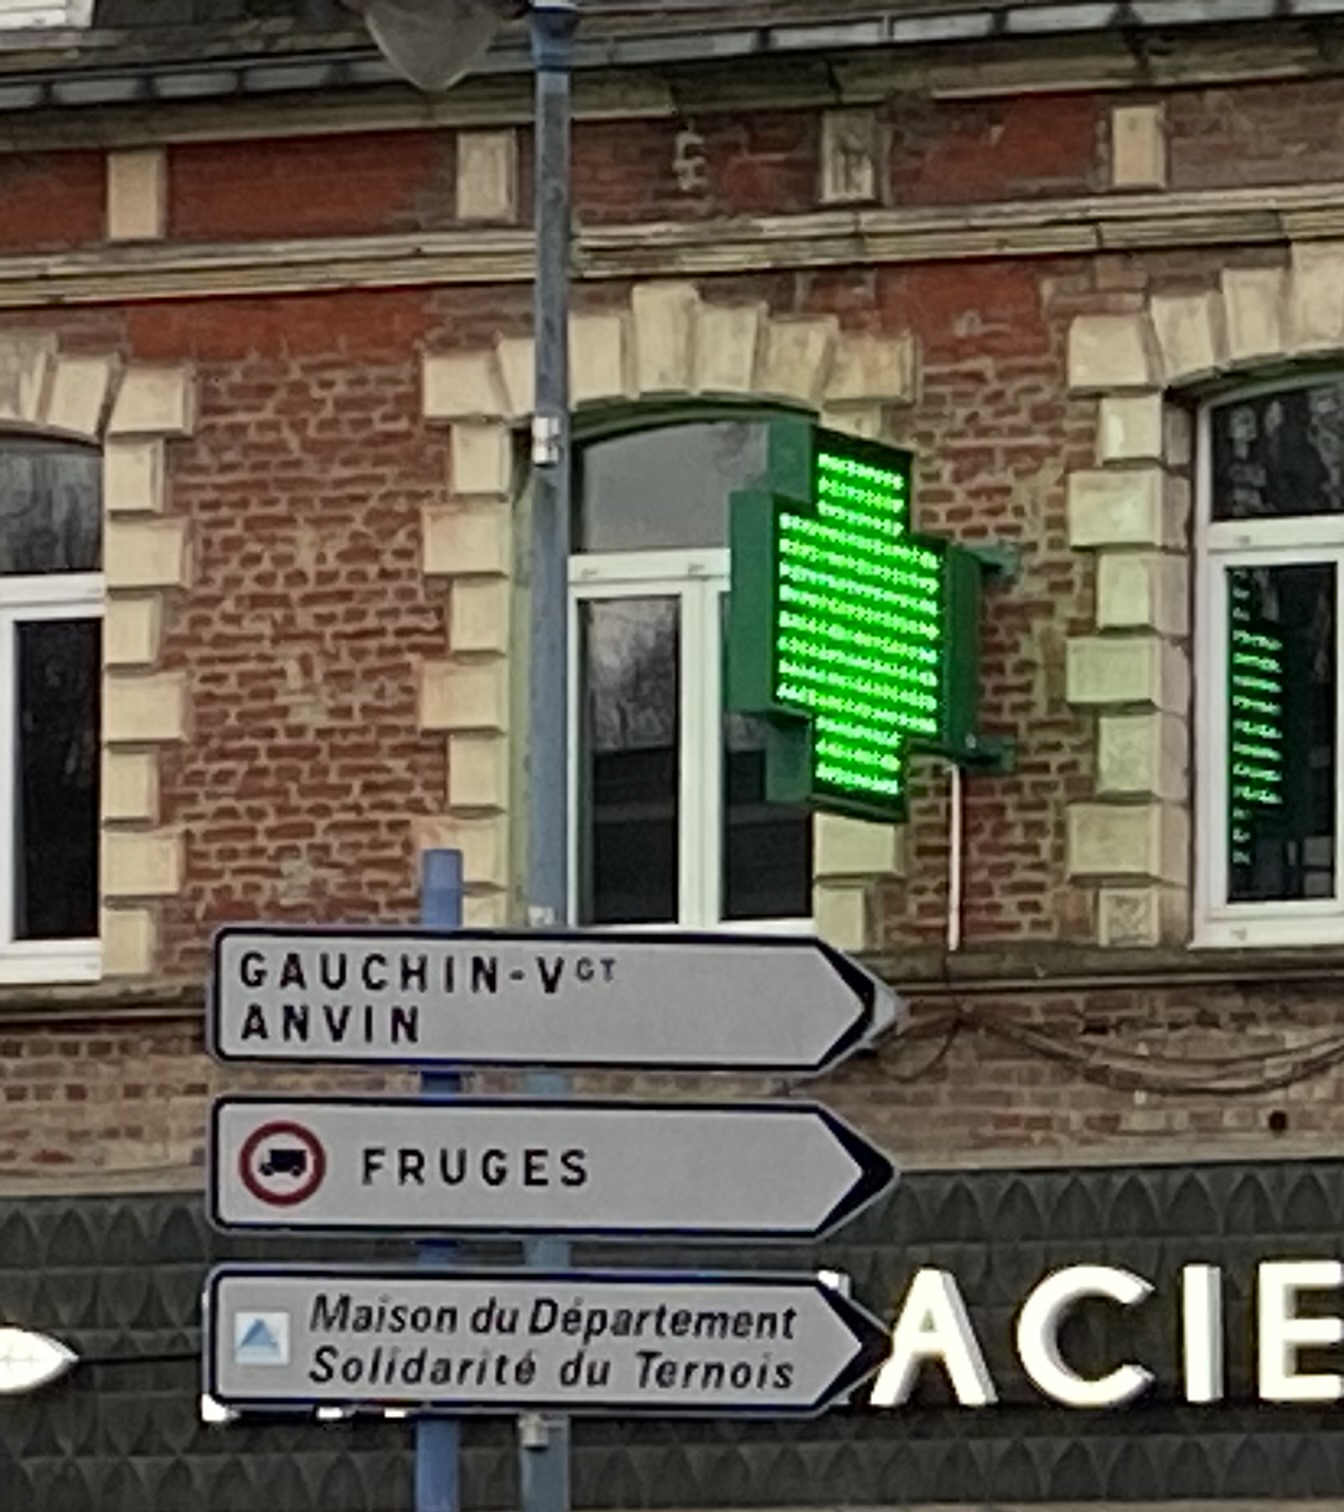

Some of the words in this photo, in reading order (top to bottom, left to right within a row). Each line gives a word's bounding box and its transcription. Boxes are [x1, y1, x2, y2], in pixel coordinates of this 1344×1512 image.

[240, 1003, 419, 1045] ANVIN
[361, 1147, 589, 1188] FRUGES
[309, 1293, 459, 1334] Maison
[469, 1296, 520, 1335] du
[528, 1296, 799, 1346] Département
[308, 1343, 537, 1386] Solidarité
[559, 1349, 611, 1388] du
[635, 1349, 794, 1390] Ternois
